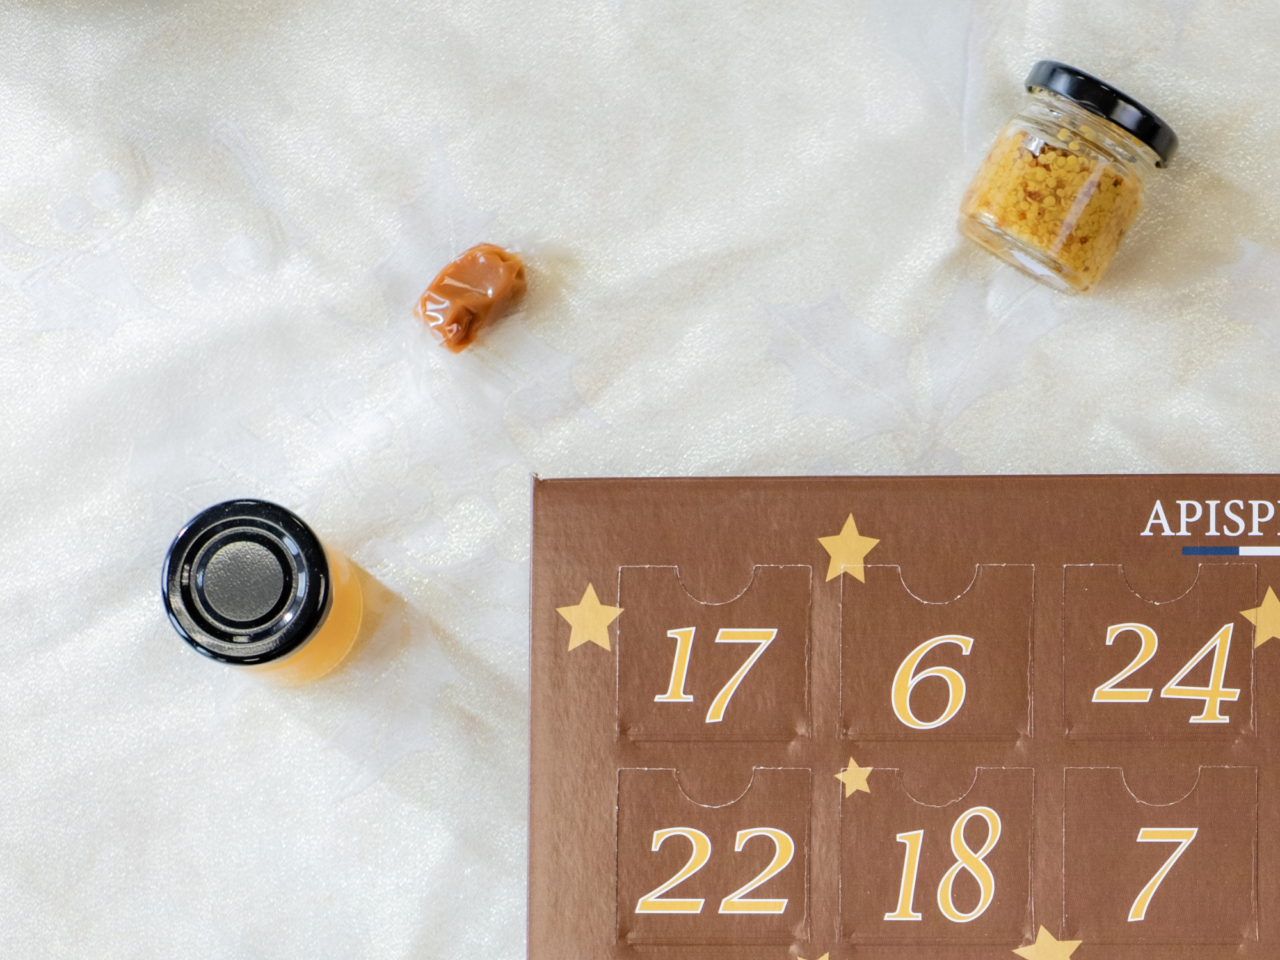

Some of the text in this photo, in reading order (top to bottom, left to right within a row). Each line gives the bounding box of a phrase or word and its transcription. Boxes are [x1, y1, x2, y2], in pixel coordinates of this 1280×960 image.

[654, 627, 778, 724] 17
[891, 634, 974, 729] 6
[1092, 622, 1240, 724] 24
[635, 826, 794, 915] 22
[883, 806, 1001, 923] 18
[1127, 827, 1198, 923] 7
